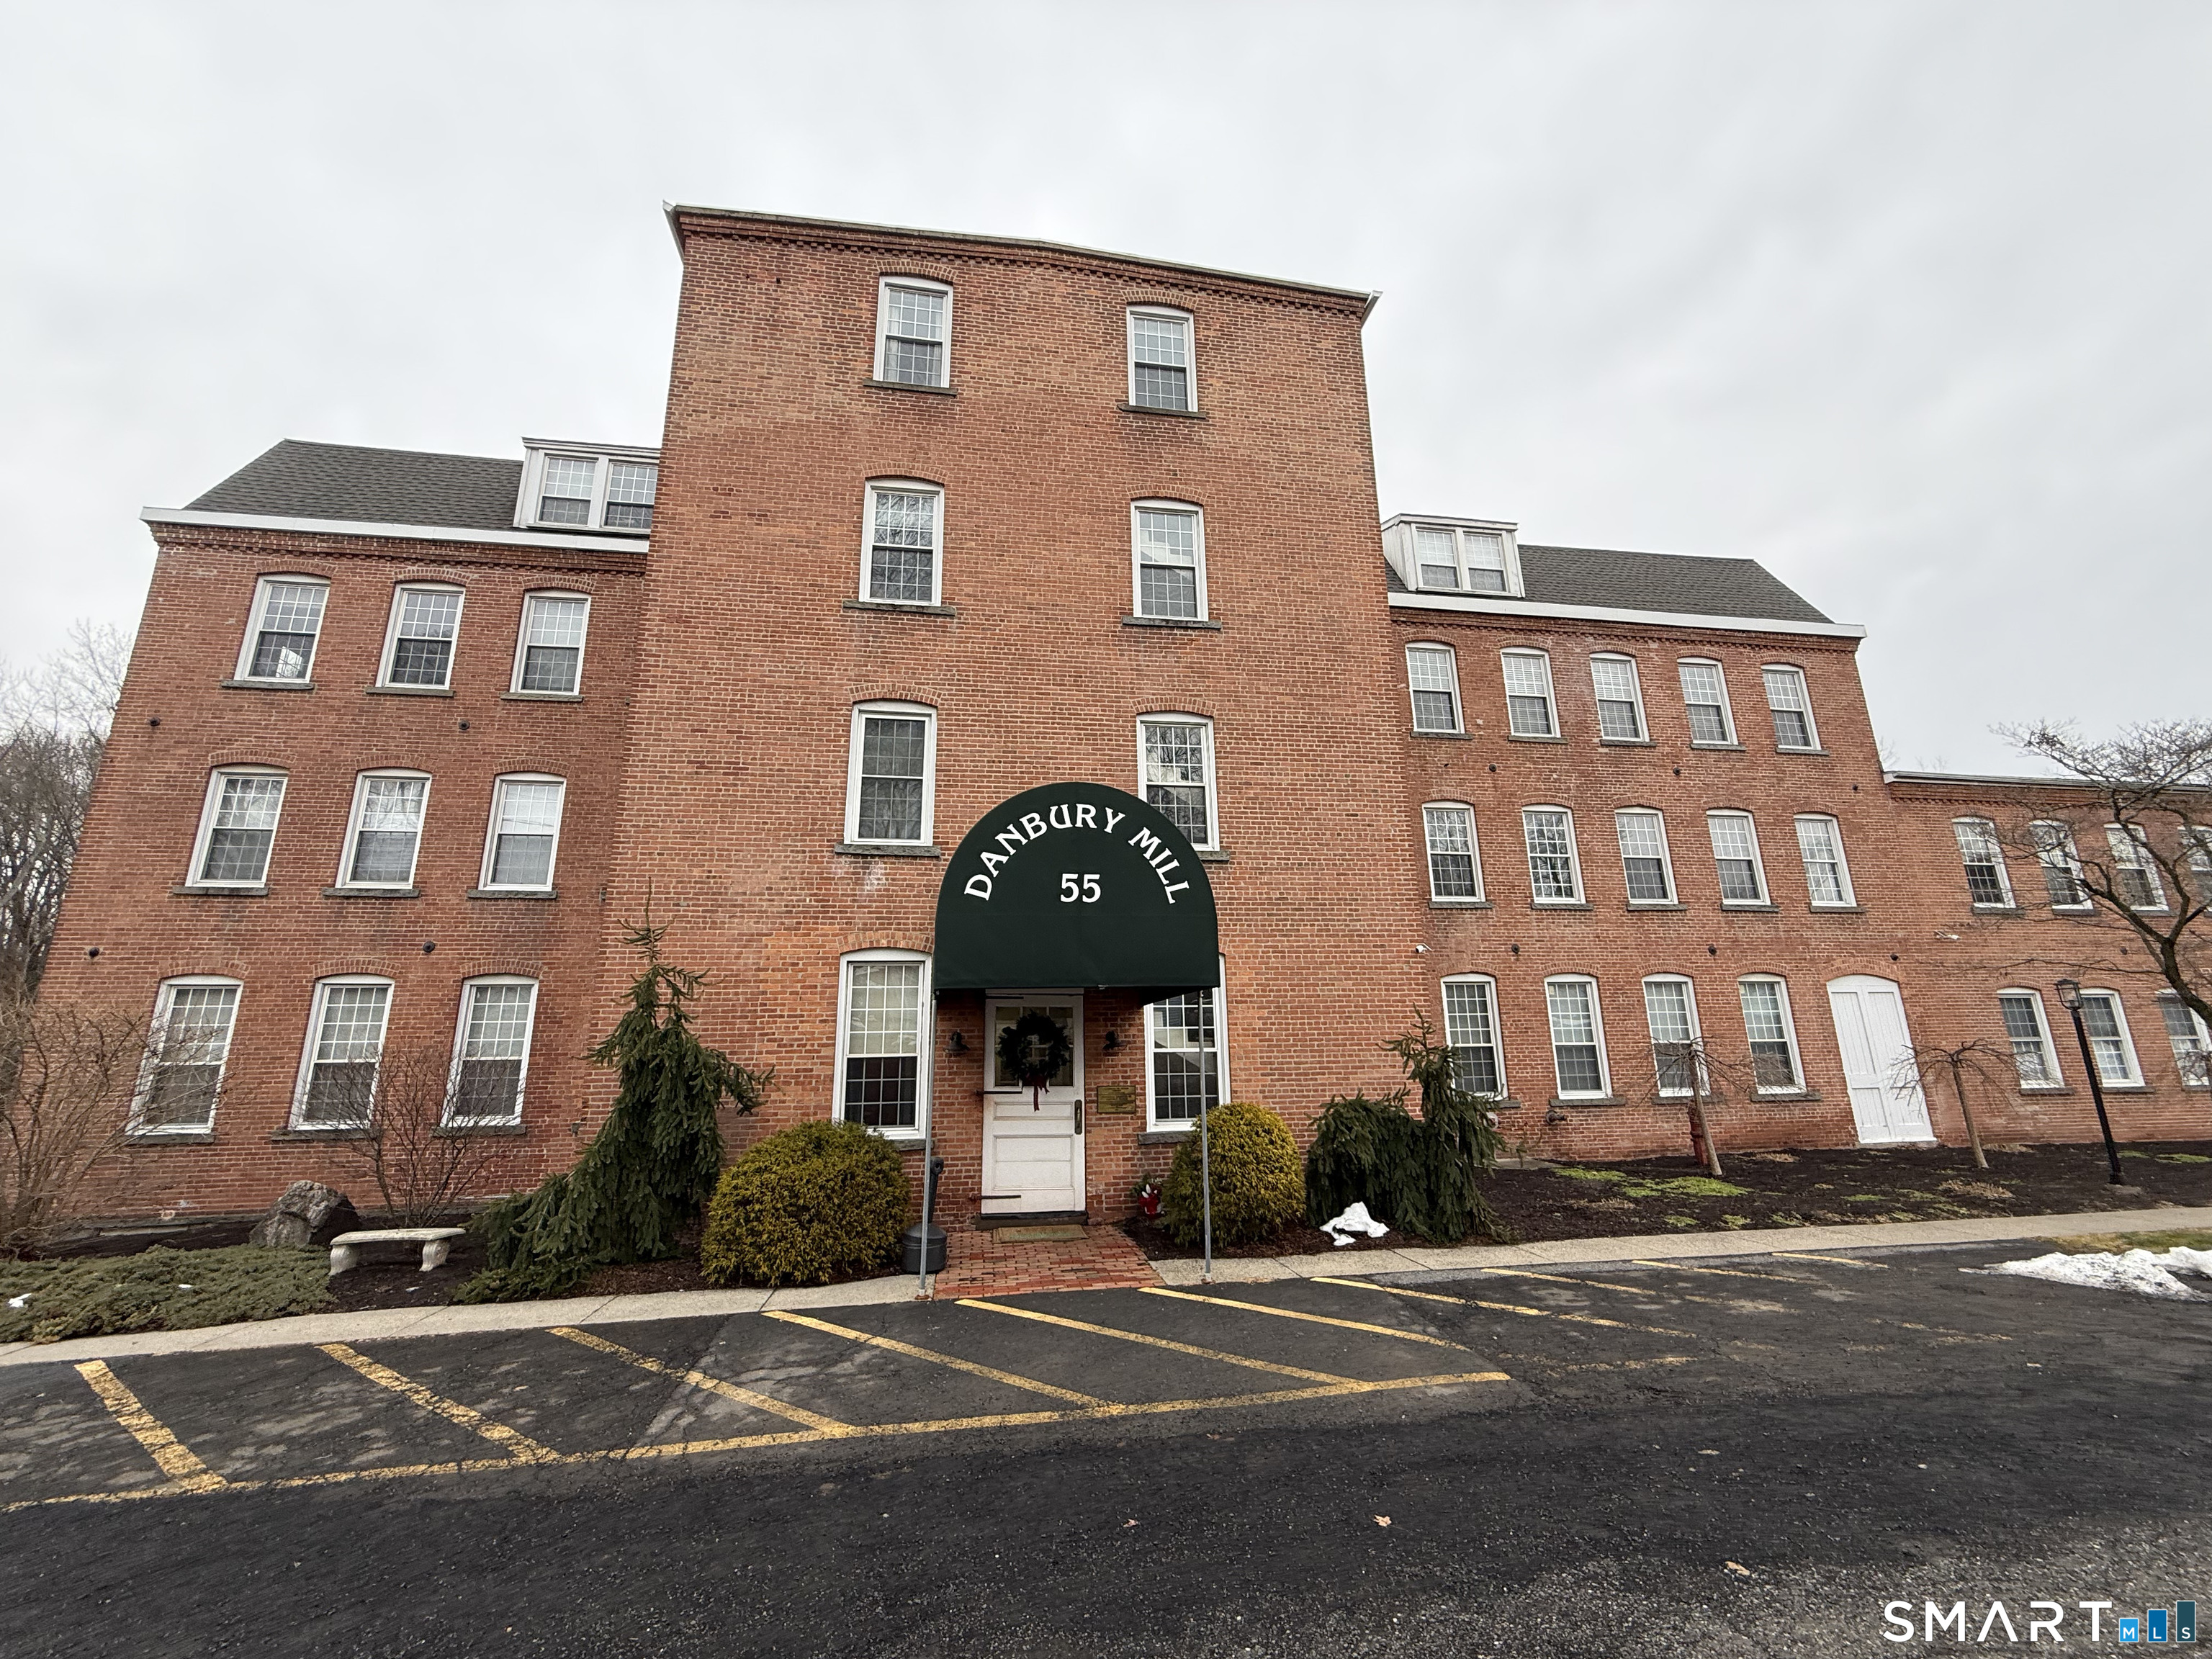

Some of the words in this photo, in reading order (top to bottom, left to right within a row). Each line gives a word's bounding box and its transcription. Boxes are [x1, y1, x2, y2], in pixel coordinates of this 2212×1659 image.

[964, 803, 1126, 901] DANBURY
[1128, 827, 1190, 904] MILL
[1060, 873, 1101, 903] 55
